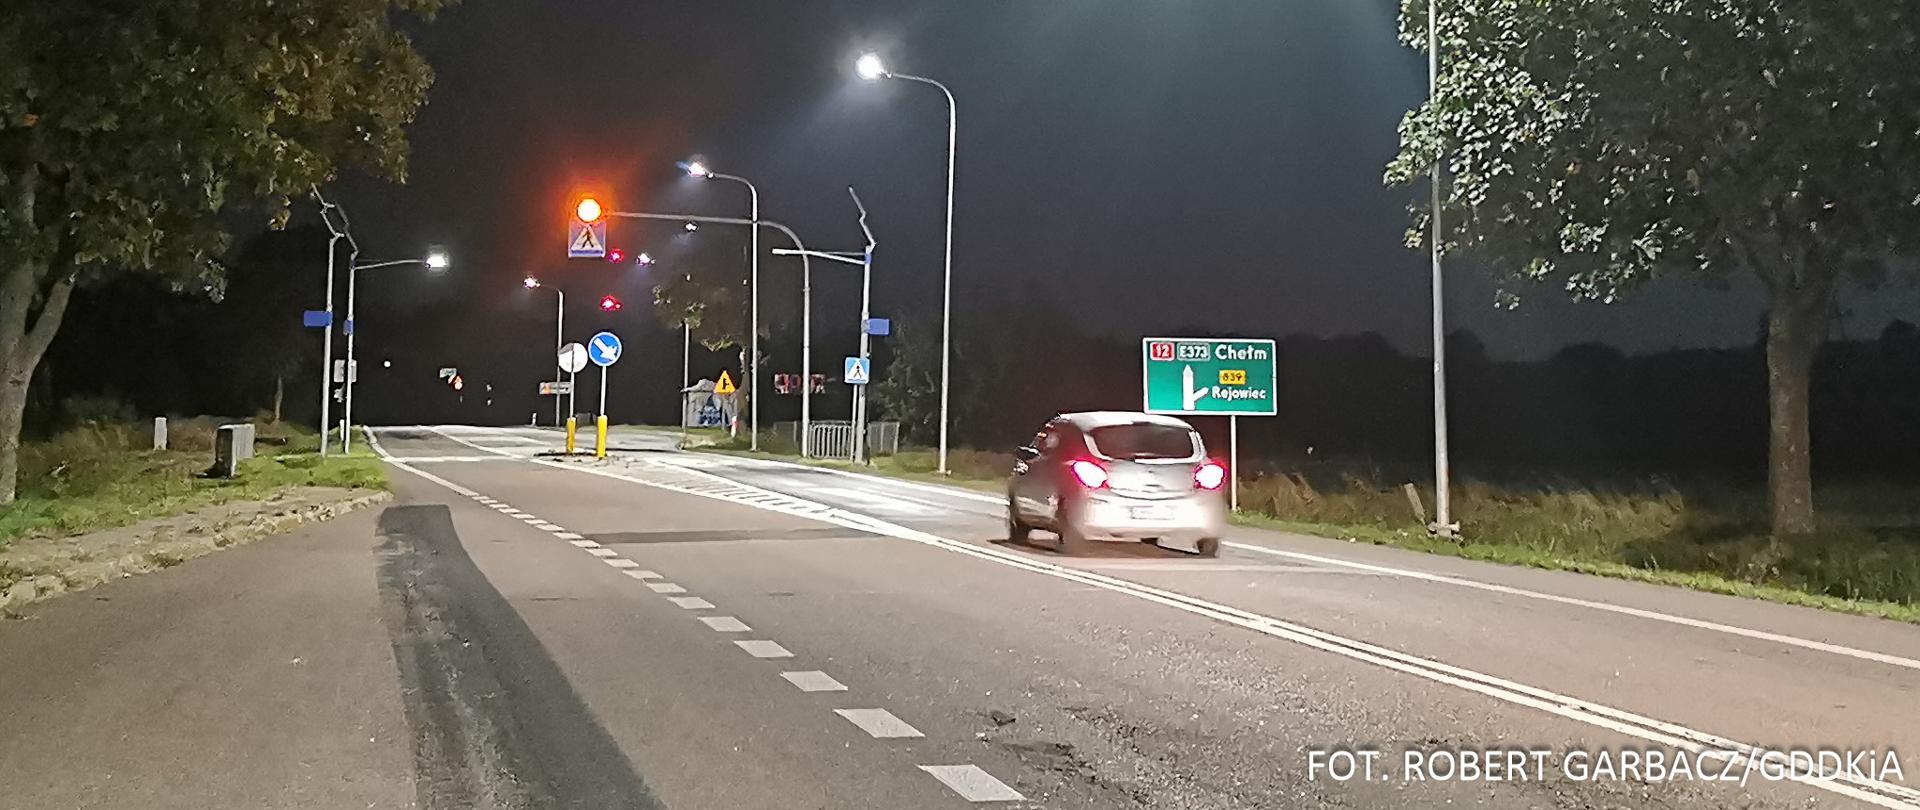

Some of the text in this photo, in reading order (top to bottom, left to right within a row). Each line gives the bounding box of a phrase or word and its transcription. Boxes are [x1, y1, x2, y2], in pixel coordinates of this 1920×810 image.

[1155, 344, 1170, 357] 12
[1180, 345, 1208, 358] E373
[1222, 372, 1242, 382] 839
[1211, 386, 1266, 401] Rejowiec
